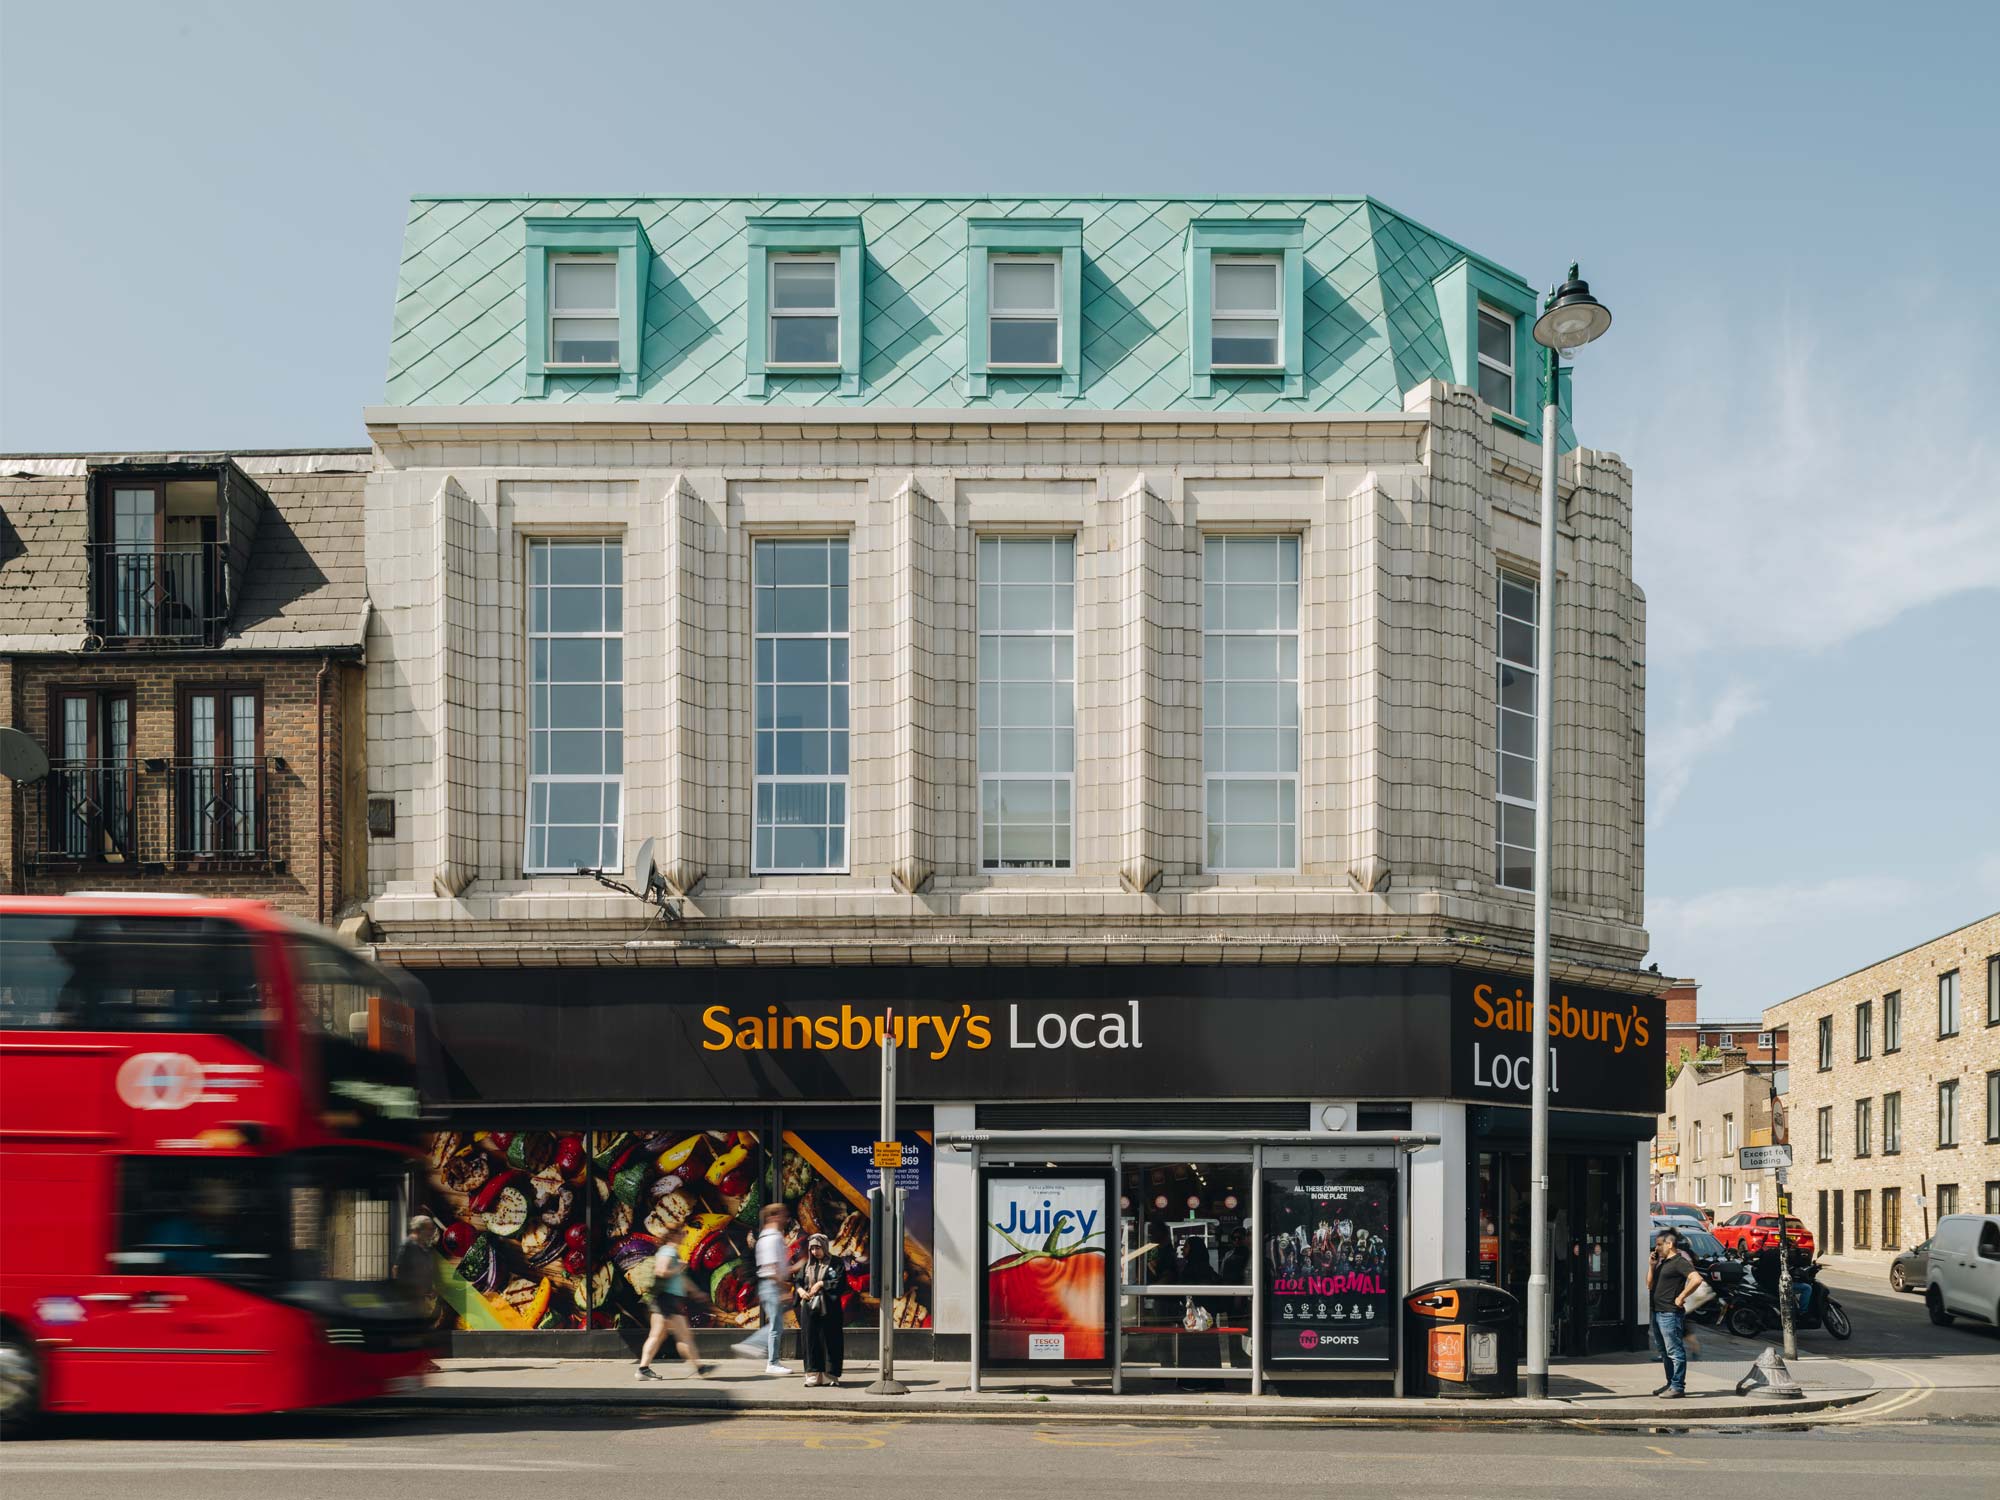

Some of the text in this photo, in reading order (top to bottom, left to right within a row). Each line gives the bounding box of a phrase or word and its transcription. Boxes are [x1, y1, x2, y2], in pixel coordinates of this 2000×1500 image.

[702, 1000, 1142, 1060] Sainsbury's Local
[1474, 1042, 1559, 1093] Locl
[851, 1145, 873, 1154] Best
[1743, 1148, 1789, 1158] Except for
[901, 1156, 919, 1166] 869
[1750, 1157, 1781, 1166] loading
[995, 1200, 1097, 1243] Juicy
[1274, 1271, 1386, 1296] not NORMAL
[1320, 1336, 1359, 1344] SPORTS
